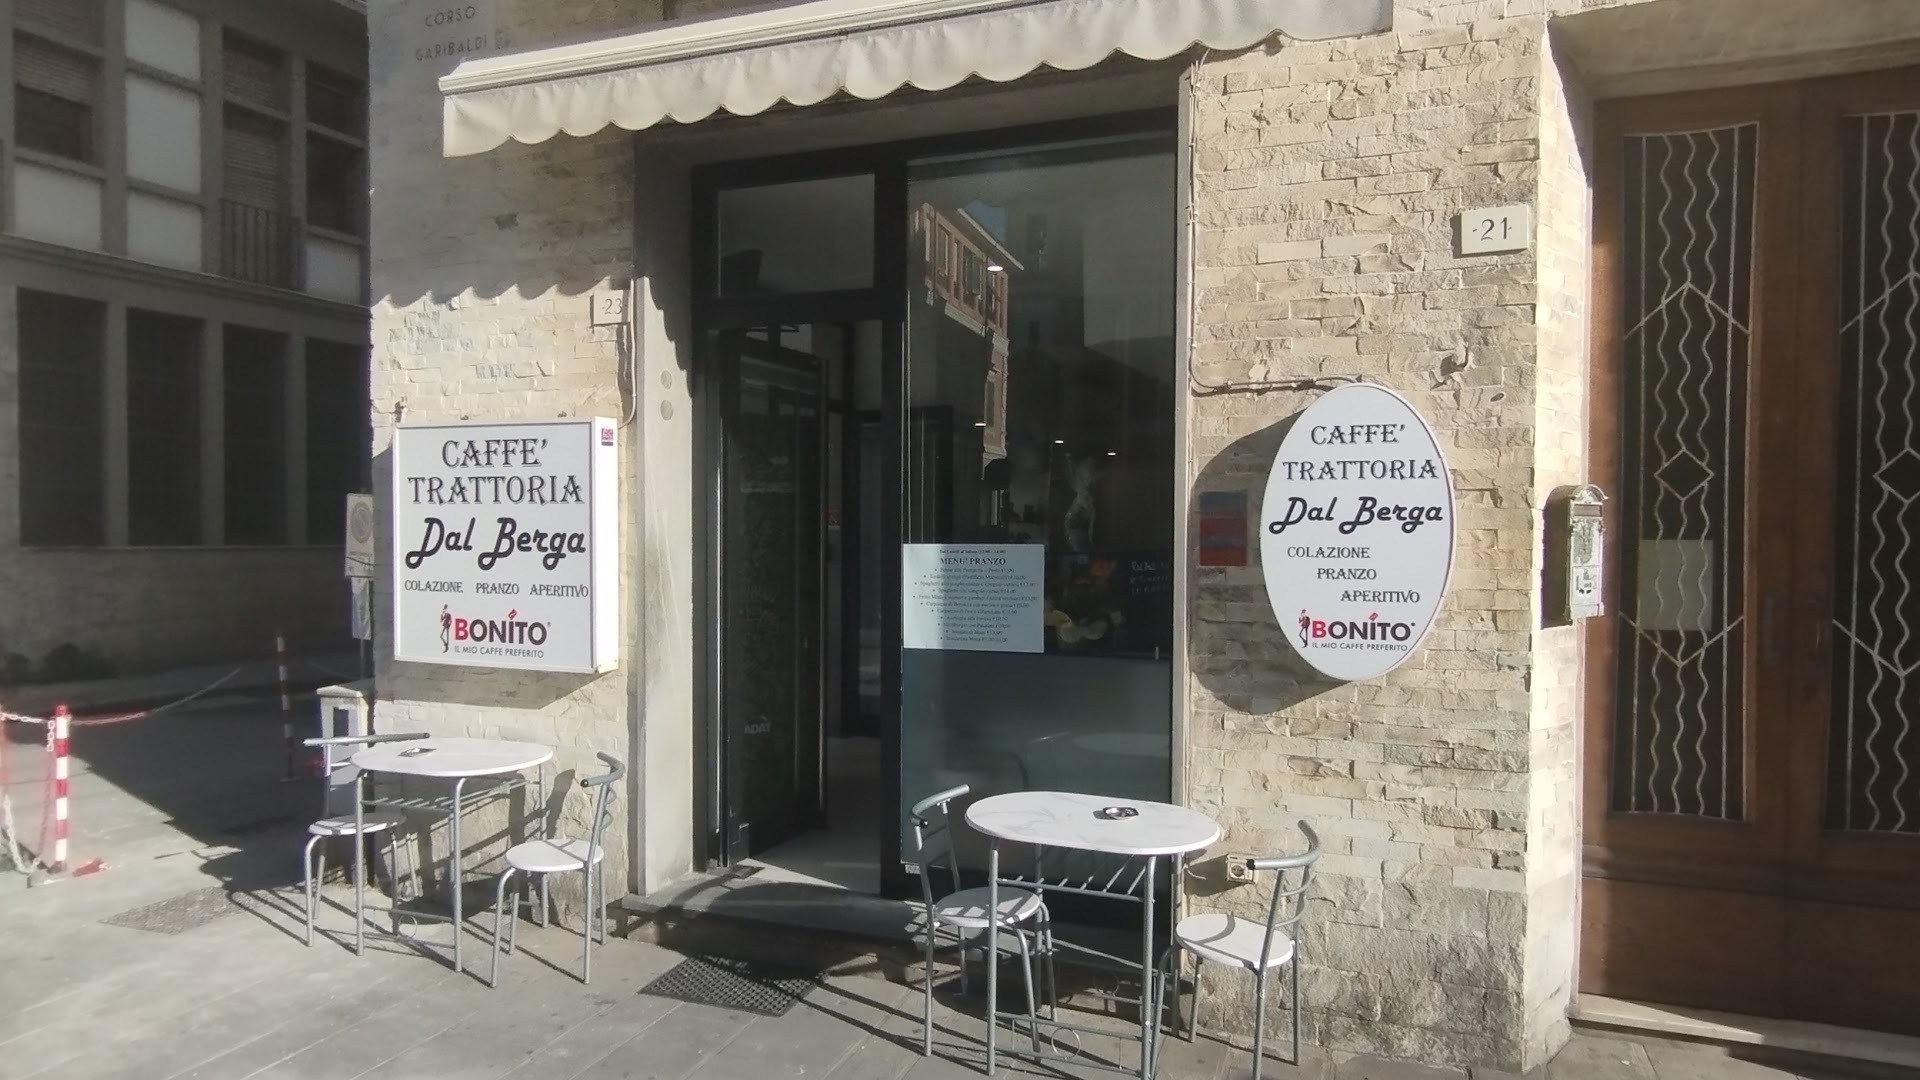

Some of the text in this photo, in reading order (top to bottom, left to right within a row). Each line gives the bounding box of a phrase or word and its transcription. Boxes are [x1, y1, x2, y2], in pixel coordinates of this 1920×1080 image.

[425, 6, 476, 27] CORSO
[415, 34, 487, 61] GARIBALDI
[1310, 423, 1406, 446] CAFFE'
[442, 438, 548, 469] CAFFE'
[1282, 459, 1439, 481] TRATTORIA
[407, 475, 584, 506] TRATTORIA
[1268, 496, 1444, 535] Dal Berga
[405, 516, 586, 571] Dal Berga
[1287, 546, 1371, 559] COLAZIONE
[969, 557, 1006, 566] PRANZO
[1317, 567, 1378, 581] PRANZO
[404, 580, 589, 598] COLAZIONE PRANZO APERITIVO
[1340, 589, 1421, 604] APERITIVO
[454, 645, 461, 653] IL
[462, 646, 478, 655] MIO
[505, 648, 545, 659] PREFERITO
[1366, 643, 1408, 651] PREFERITO
